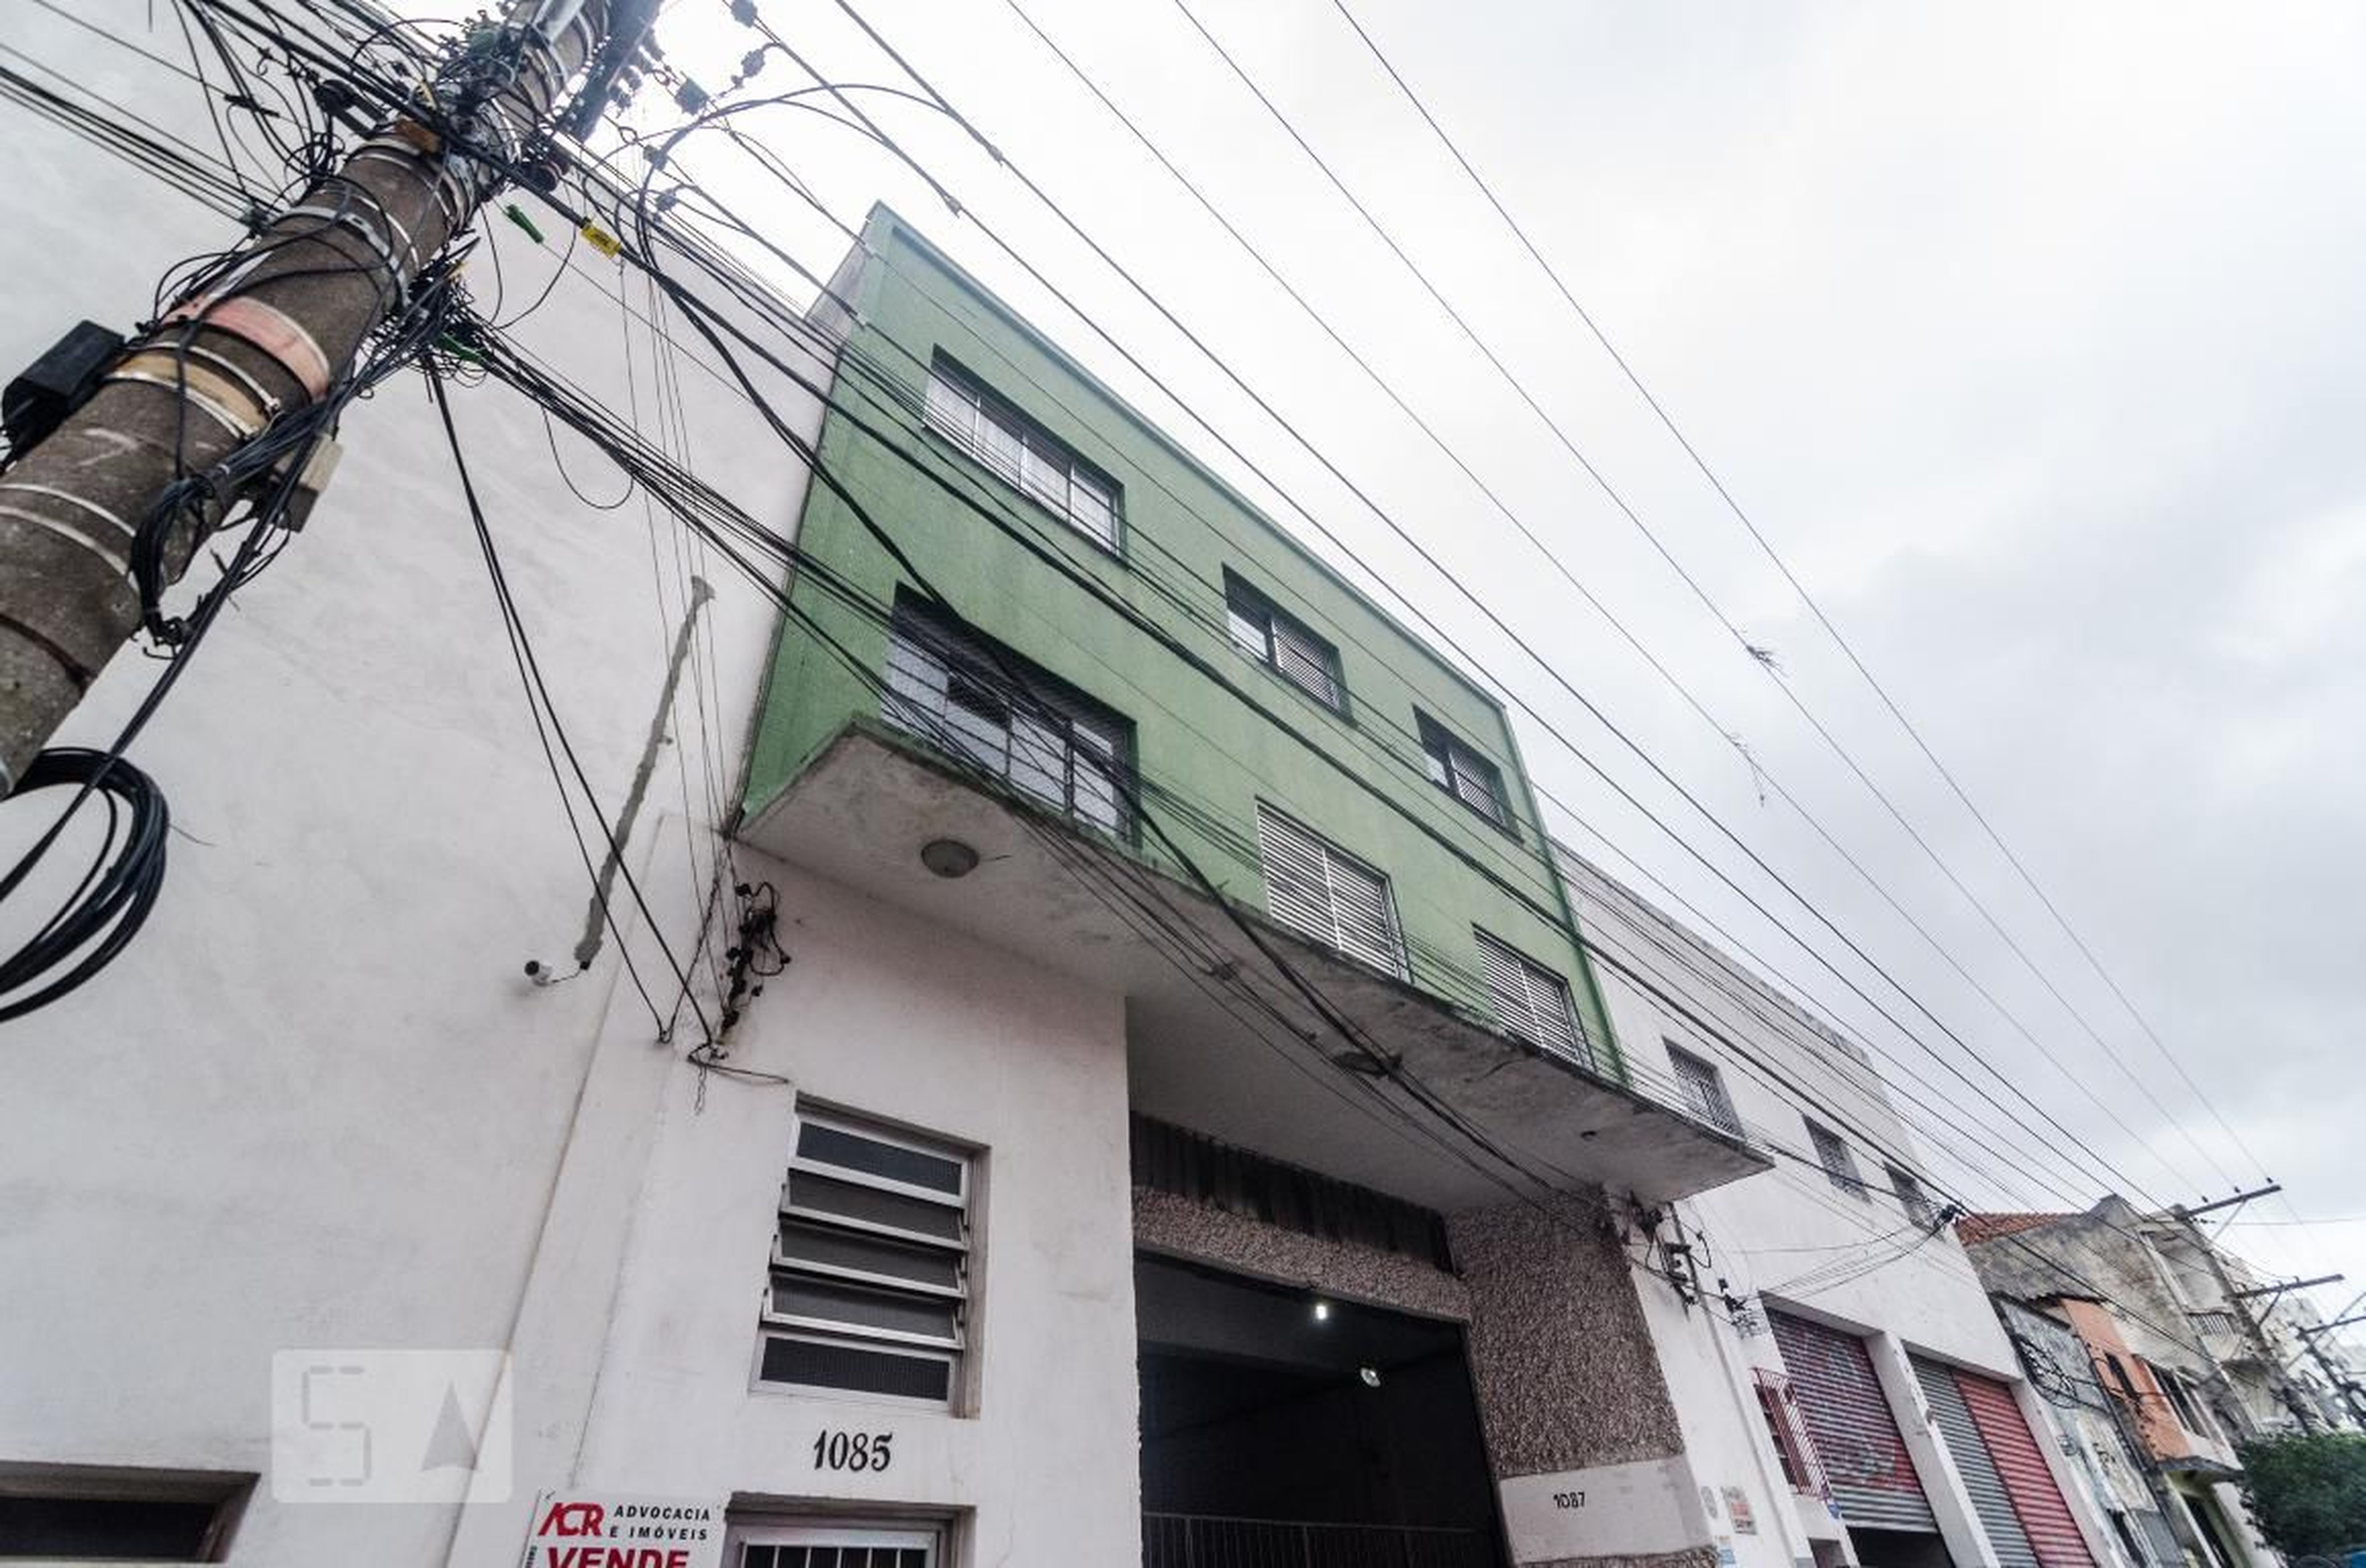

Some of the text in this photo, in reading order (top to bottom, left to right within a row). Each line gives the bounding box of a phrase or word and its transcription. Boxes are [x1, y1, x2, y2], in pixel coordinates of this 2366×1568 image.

[814, 1429, 893, 1473] 1085
[1553, 1492, 1585, 1509] 1087
[614, 1505, 710, 1521] ADVOCACIA
[609, 1525, 708, 1540] E IMÓVEIS
[548, 1547, 689, 1568] VENDE
